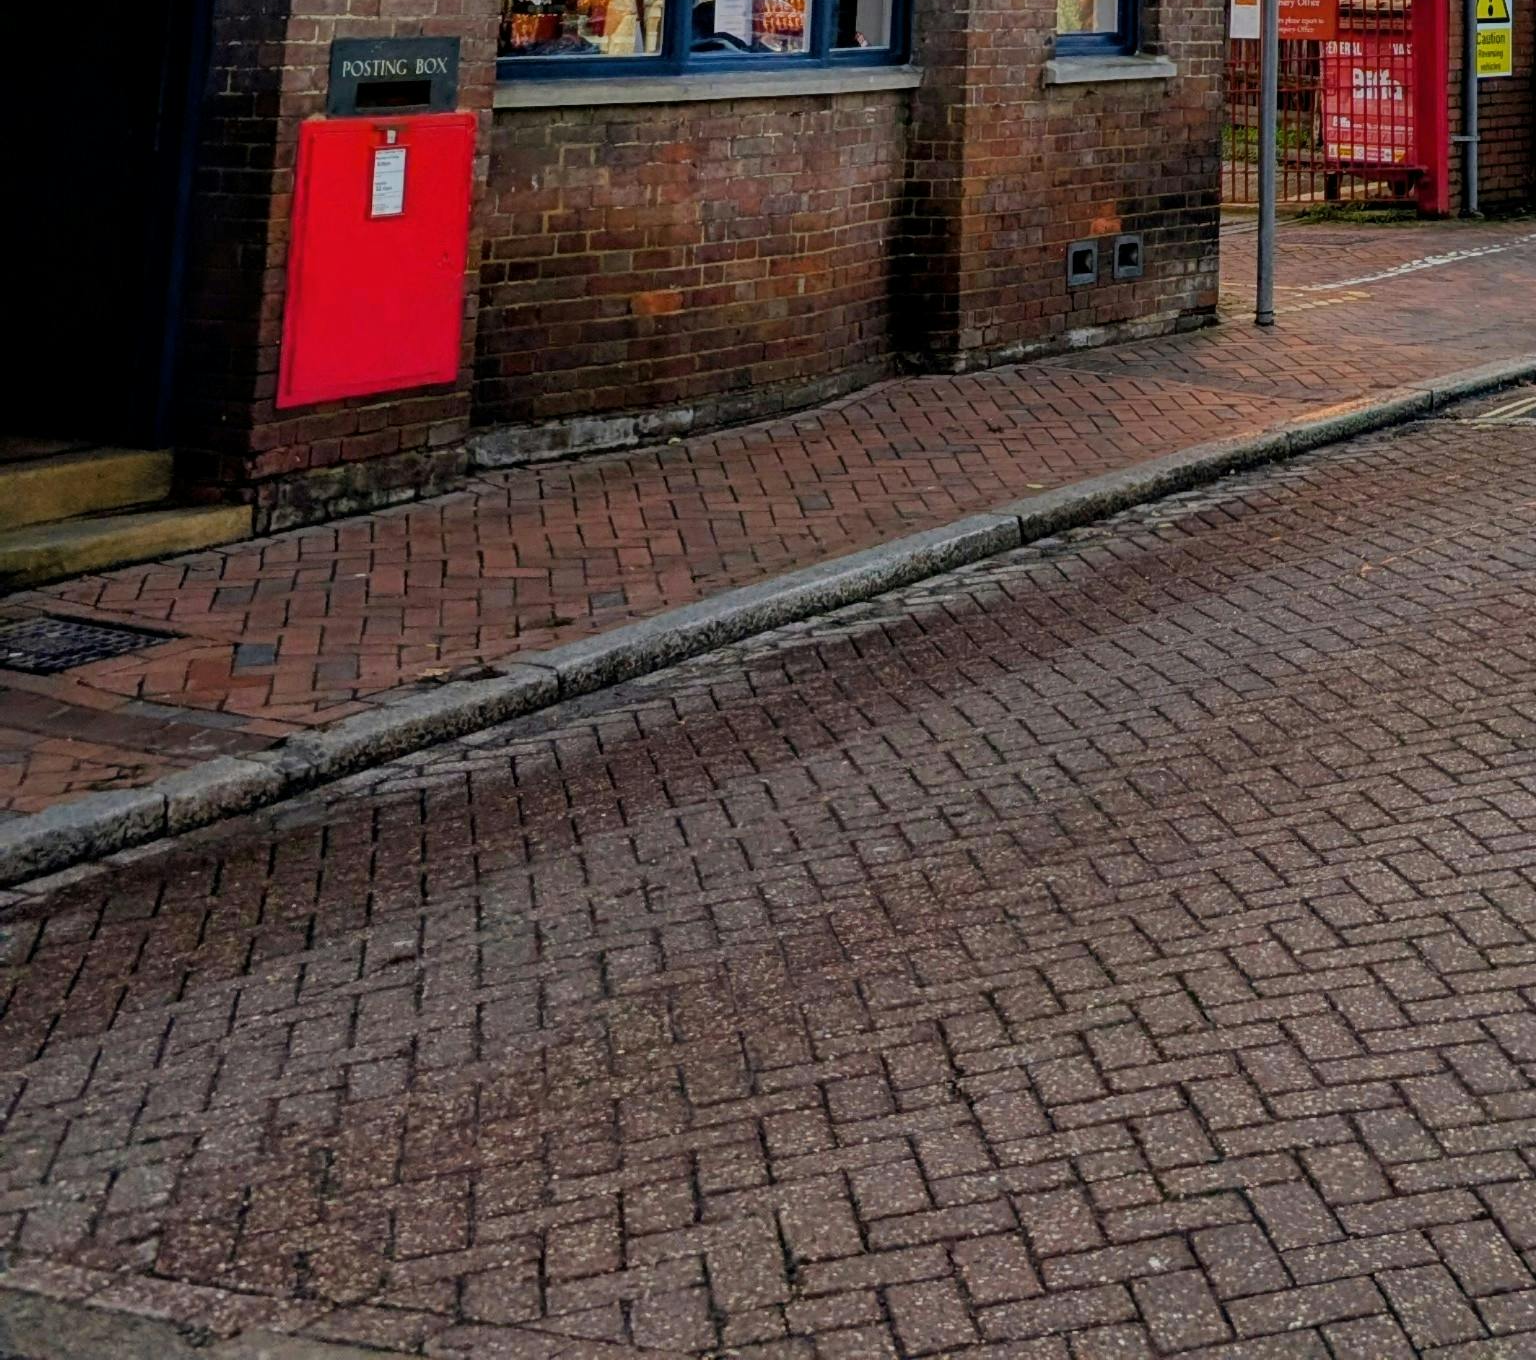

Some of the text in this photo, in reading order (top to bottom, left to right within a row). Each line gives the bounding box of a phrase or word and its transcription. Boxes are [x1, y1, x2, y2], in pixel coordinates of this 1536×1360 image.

[1476, 32, 1506, 45] Caution
[342, 57, 448, 77] POSTING BOX
